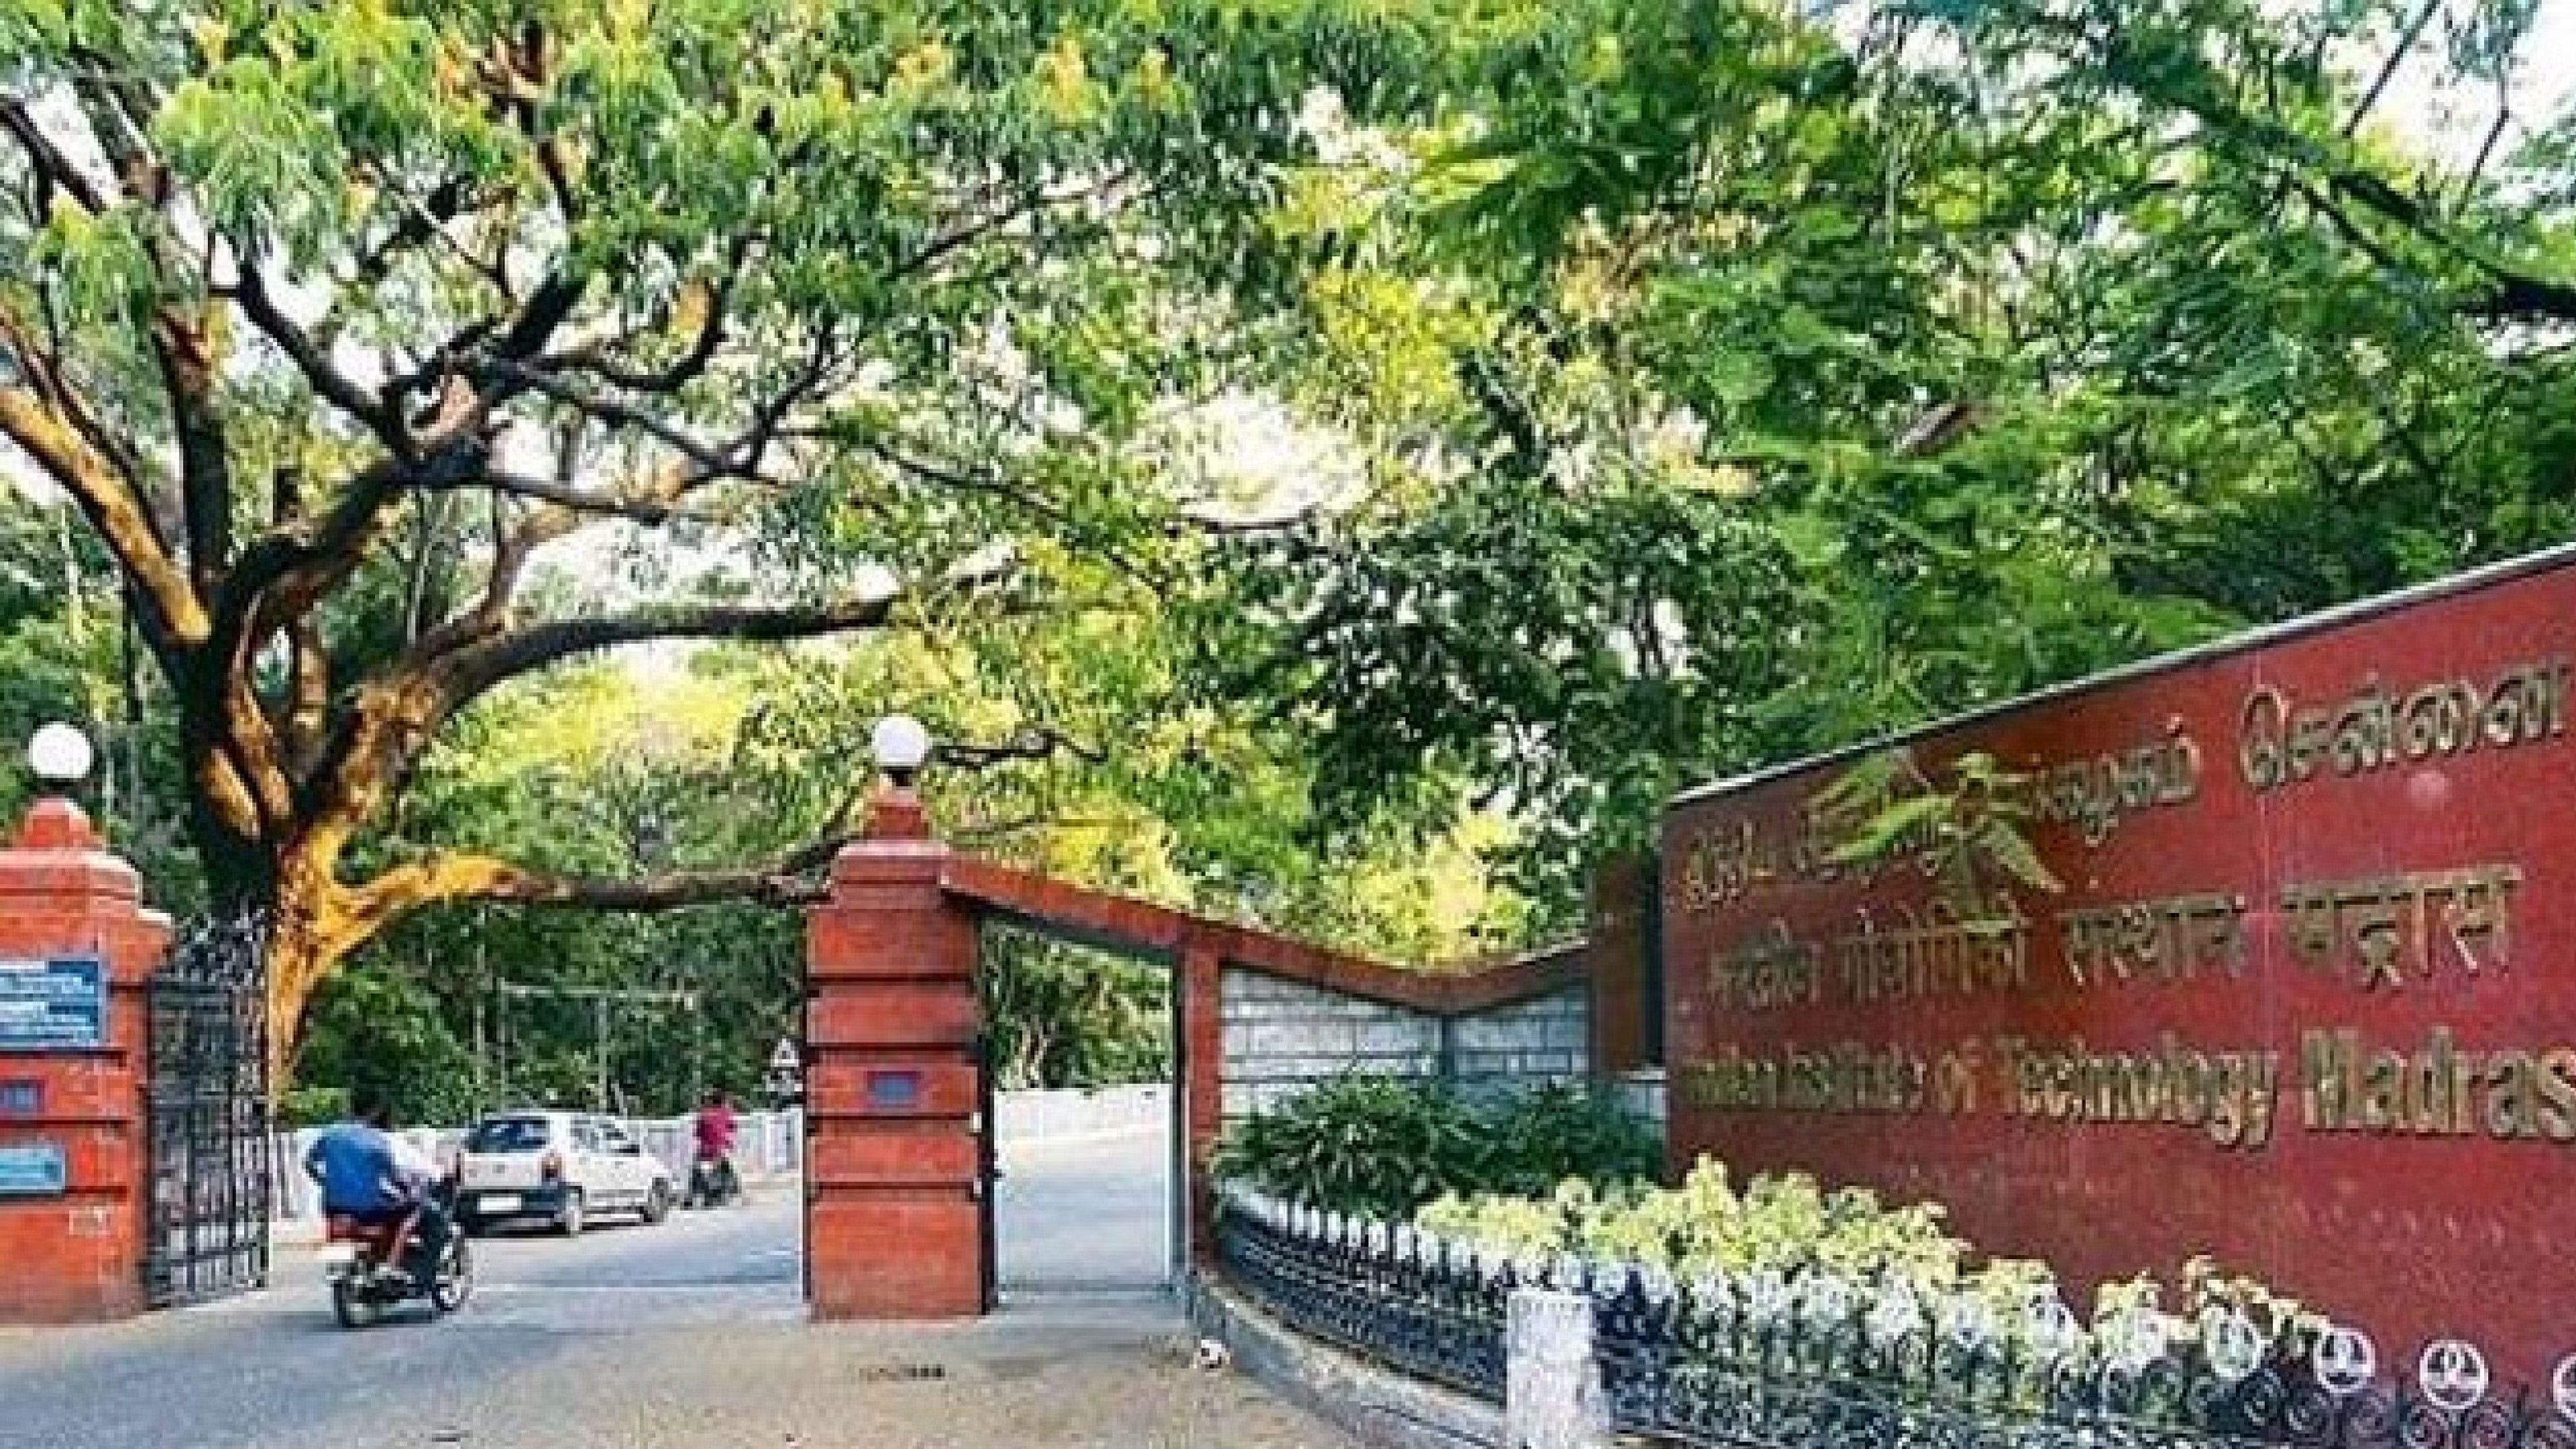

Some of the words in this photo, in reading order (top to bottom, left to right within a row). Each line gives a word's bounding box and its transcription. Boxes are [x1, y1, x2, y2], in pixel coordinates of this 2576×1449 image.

[2279, 861, 2522, 987] मद्रास
[1995, 1029, 2278, 1143] Technology
[2301, 1025, 2576, 1139] Madras
